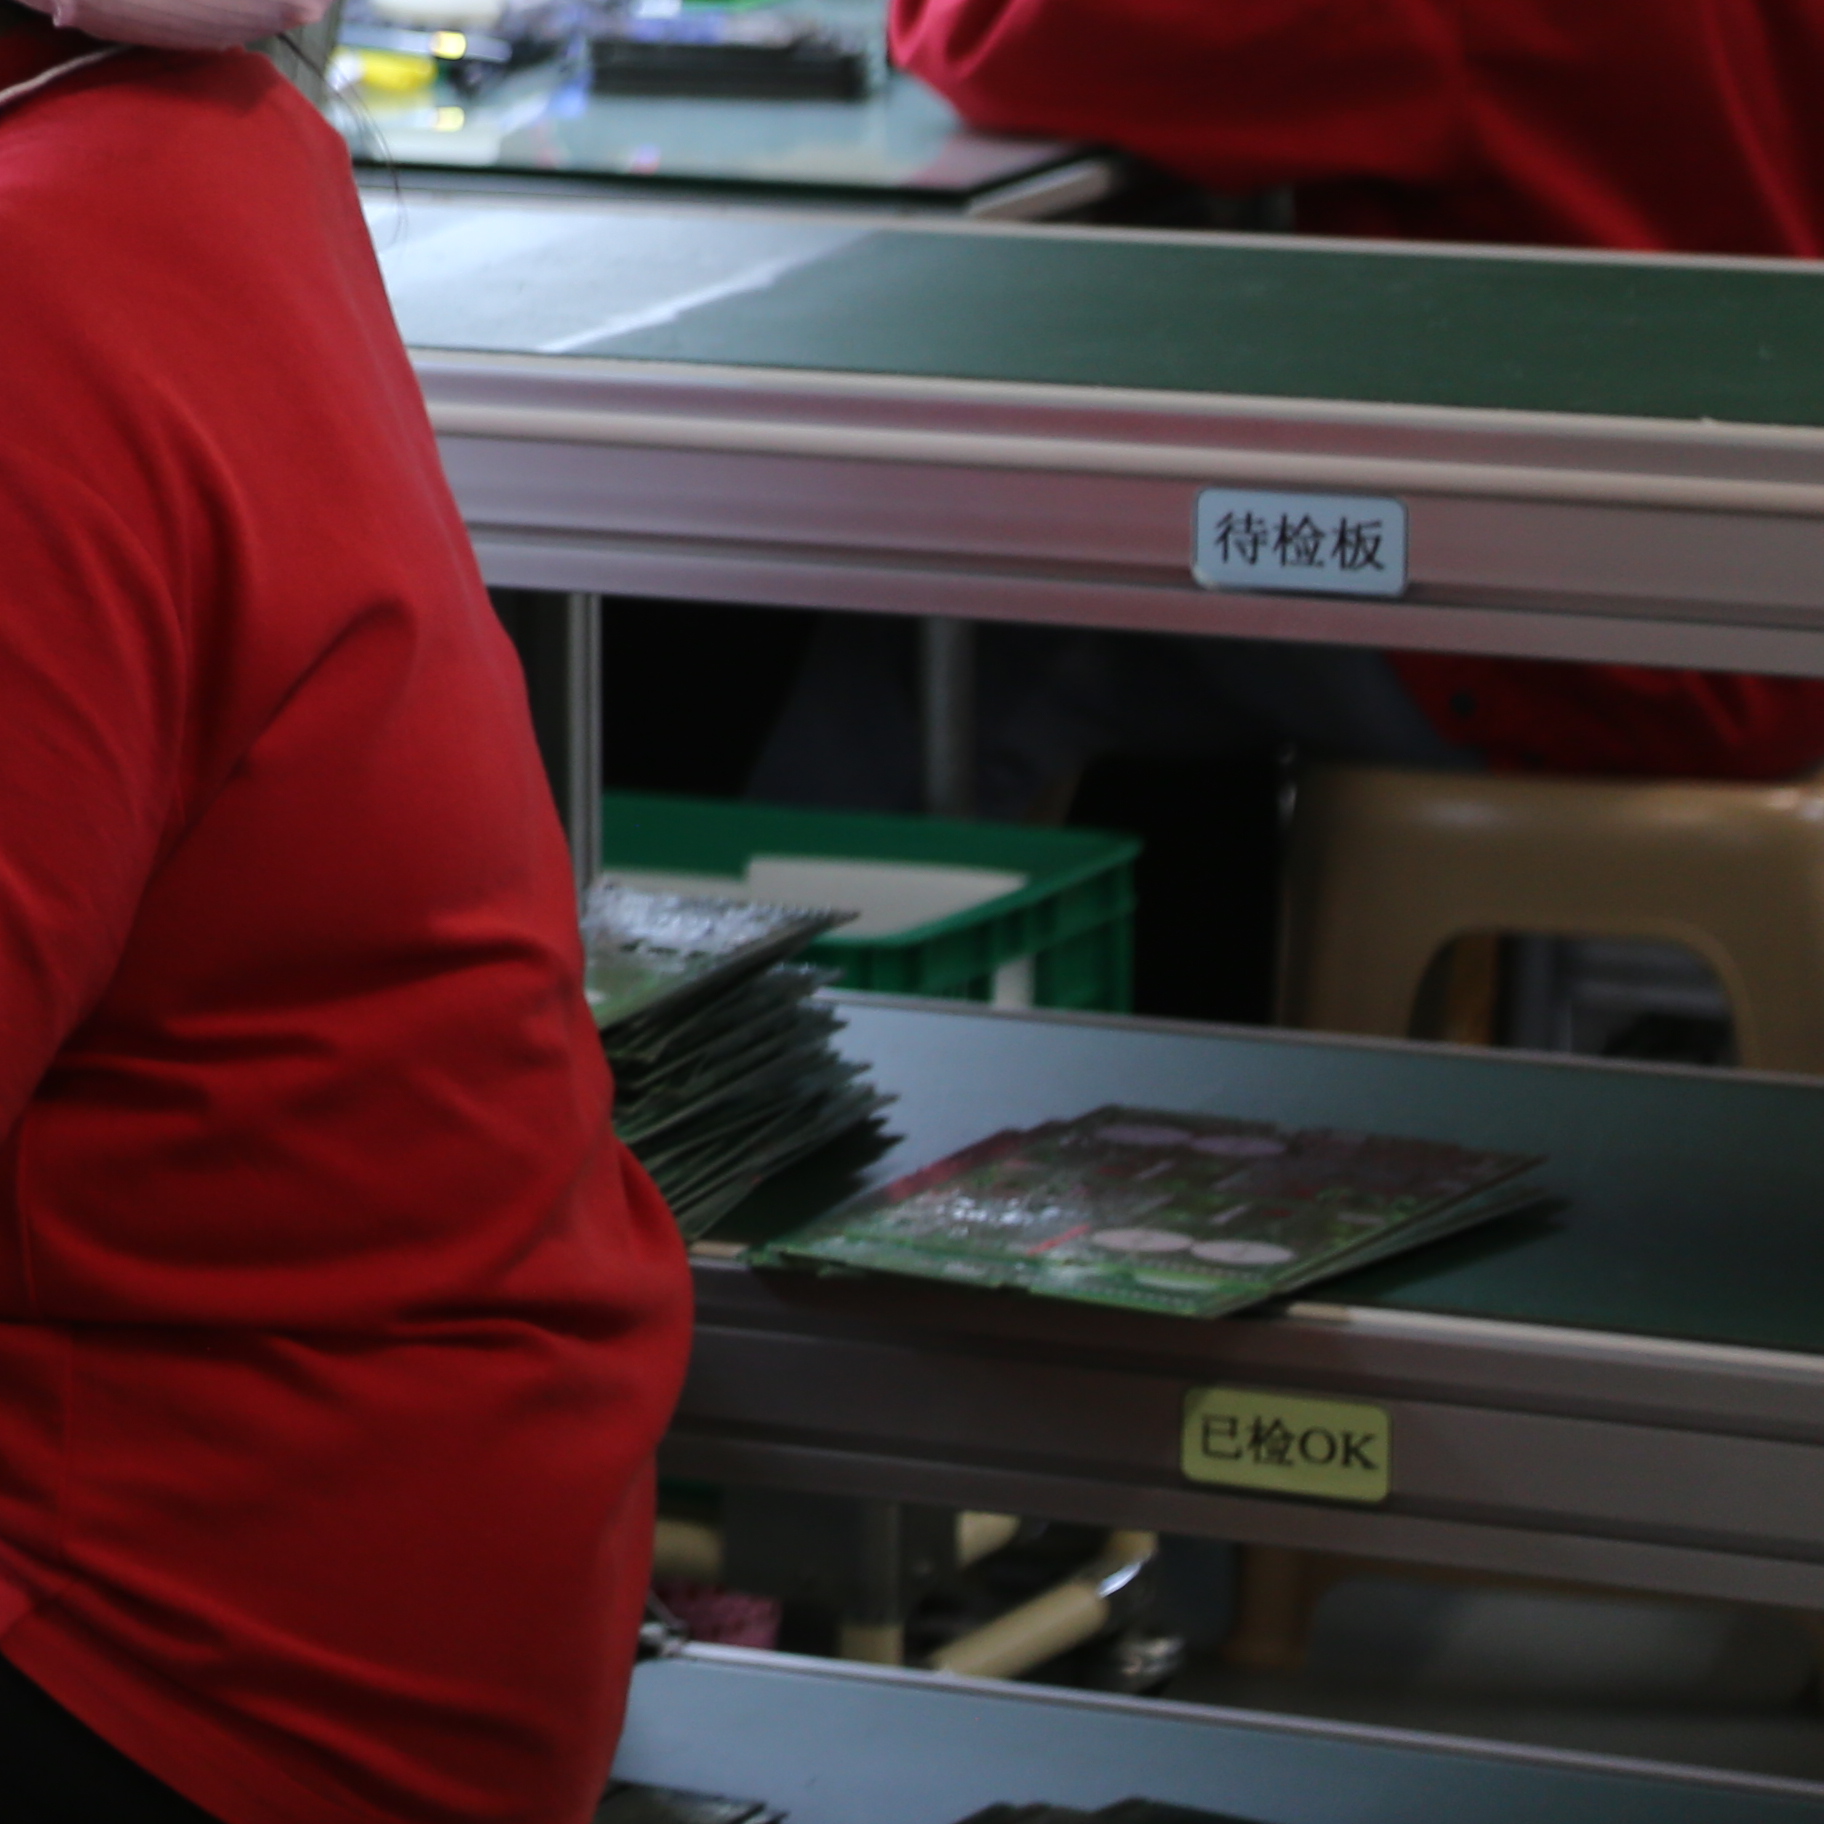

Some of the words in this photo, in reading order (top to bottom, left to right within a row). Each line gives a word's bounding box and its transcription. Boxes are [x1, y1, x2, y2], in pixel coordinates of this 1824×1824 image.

[1213, 510, 1385, 571] 待检板
[1202, 1414, 1379, 1470] 已检OK
